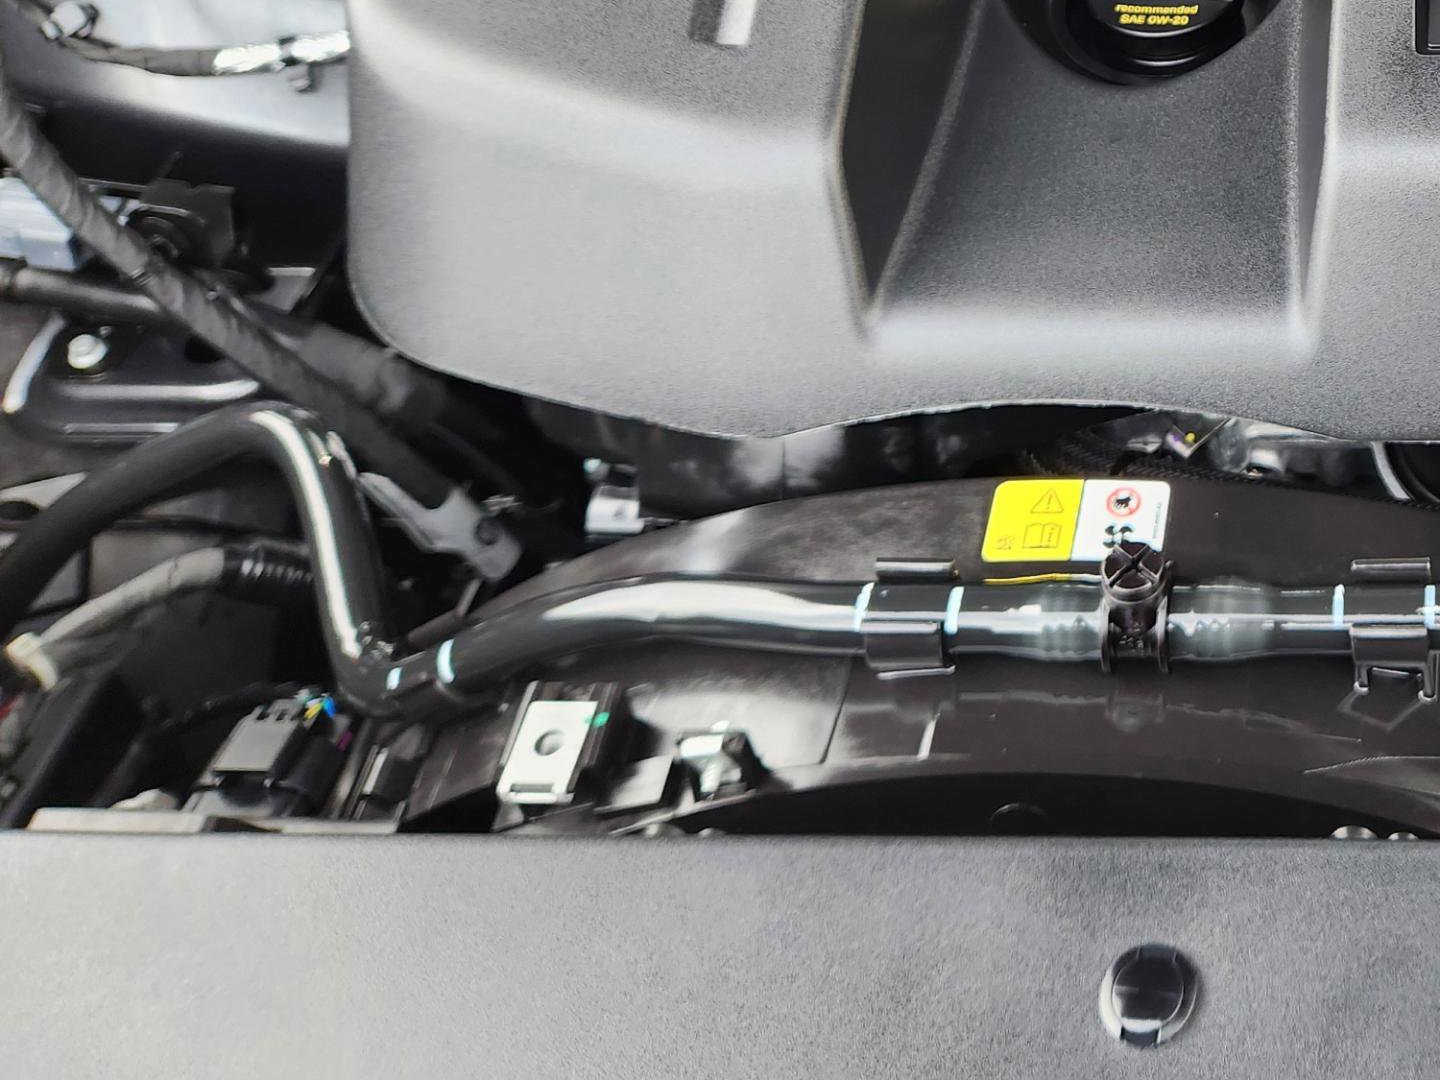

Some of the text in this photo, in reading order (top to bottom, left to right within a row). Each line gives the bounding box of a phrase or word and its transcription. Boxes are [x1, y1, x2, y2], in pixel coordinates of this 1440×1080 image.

[1114, 3, 1199, 15] recommended
[1119, 14, 1190, 25] SAE 0W-20
